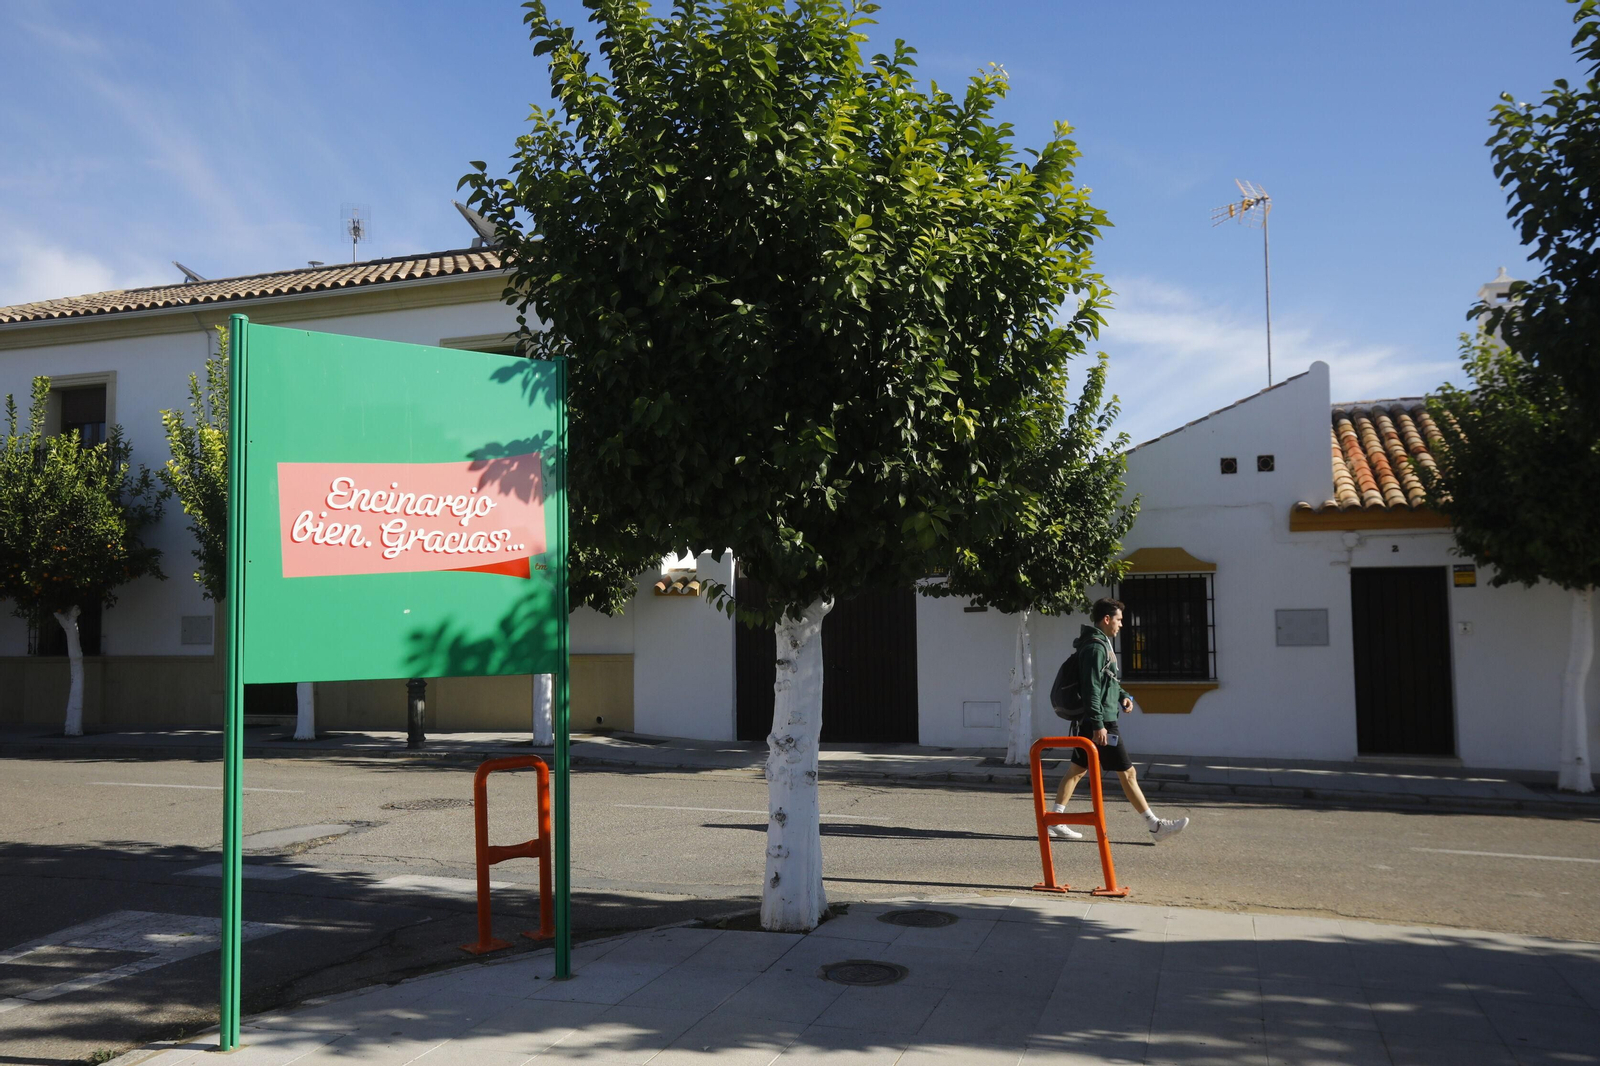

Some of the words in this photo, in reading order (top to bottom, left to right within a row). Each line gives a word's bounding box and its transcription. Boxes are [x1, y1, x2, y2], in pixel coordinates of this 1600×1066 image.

[326, 476, 497, 526] Encinarejo
[291, 510, 372, 548] bien.
[1391, 544, 1400, 553] 2
